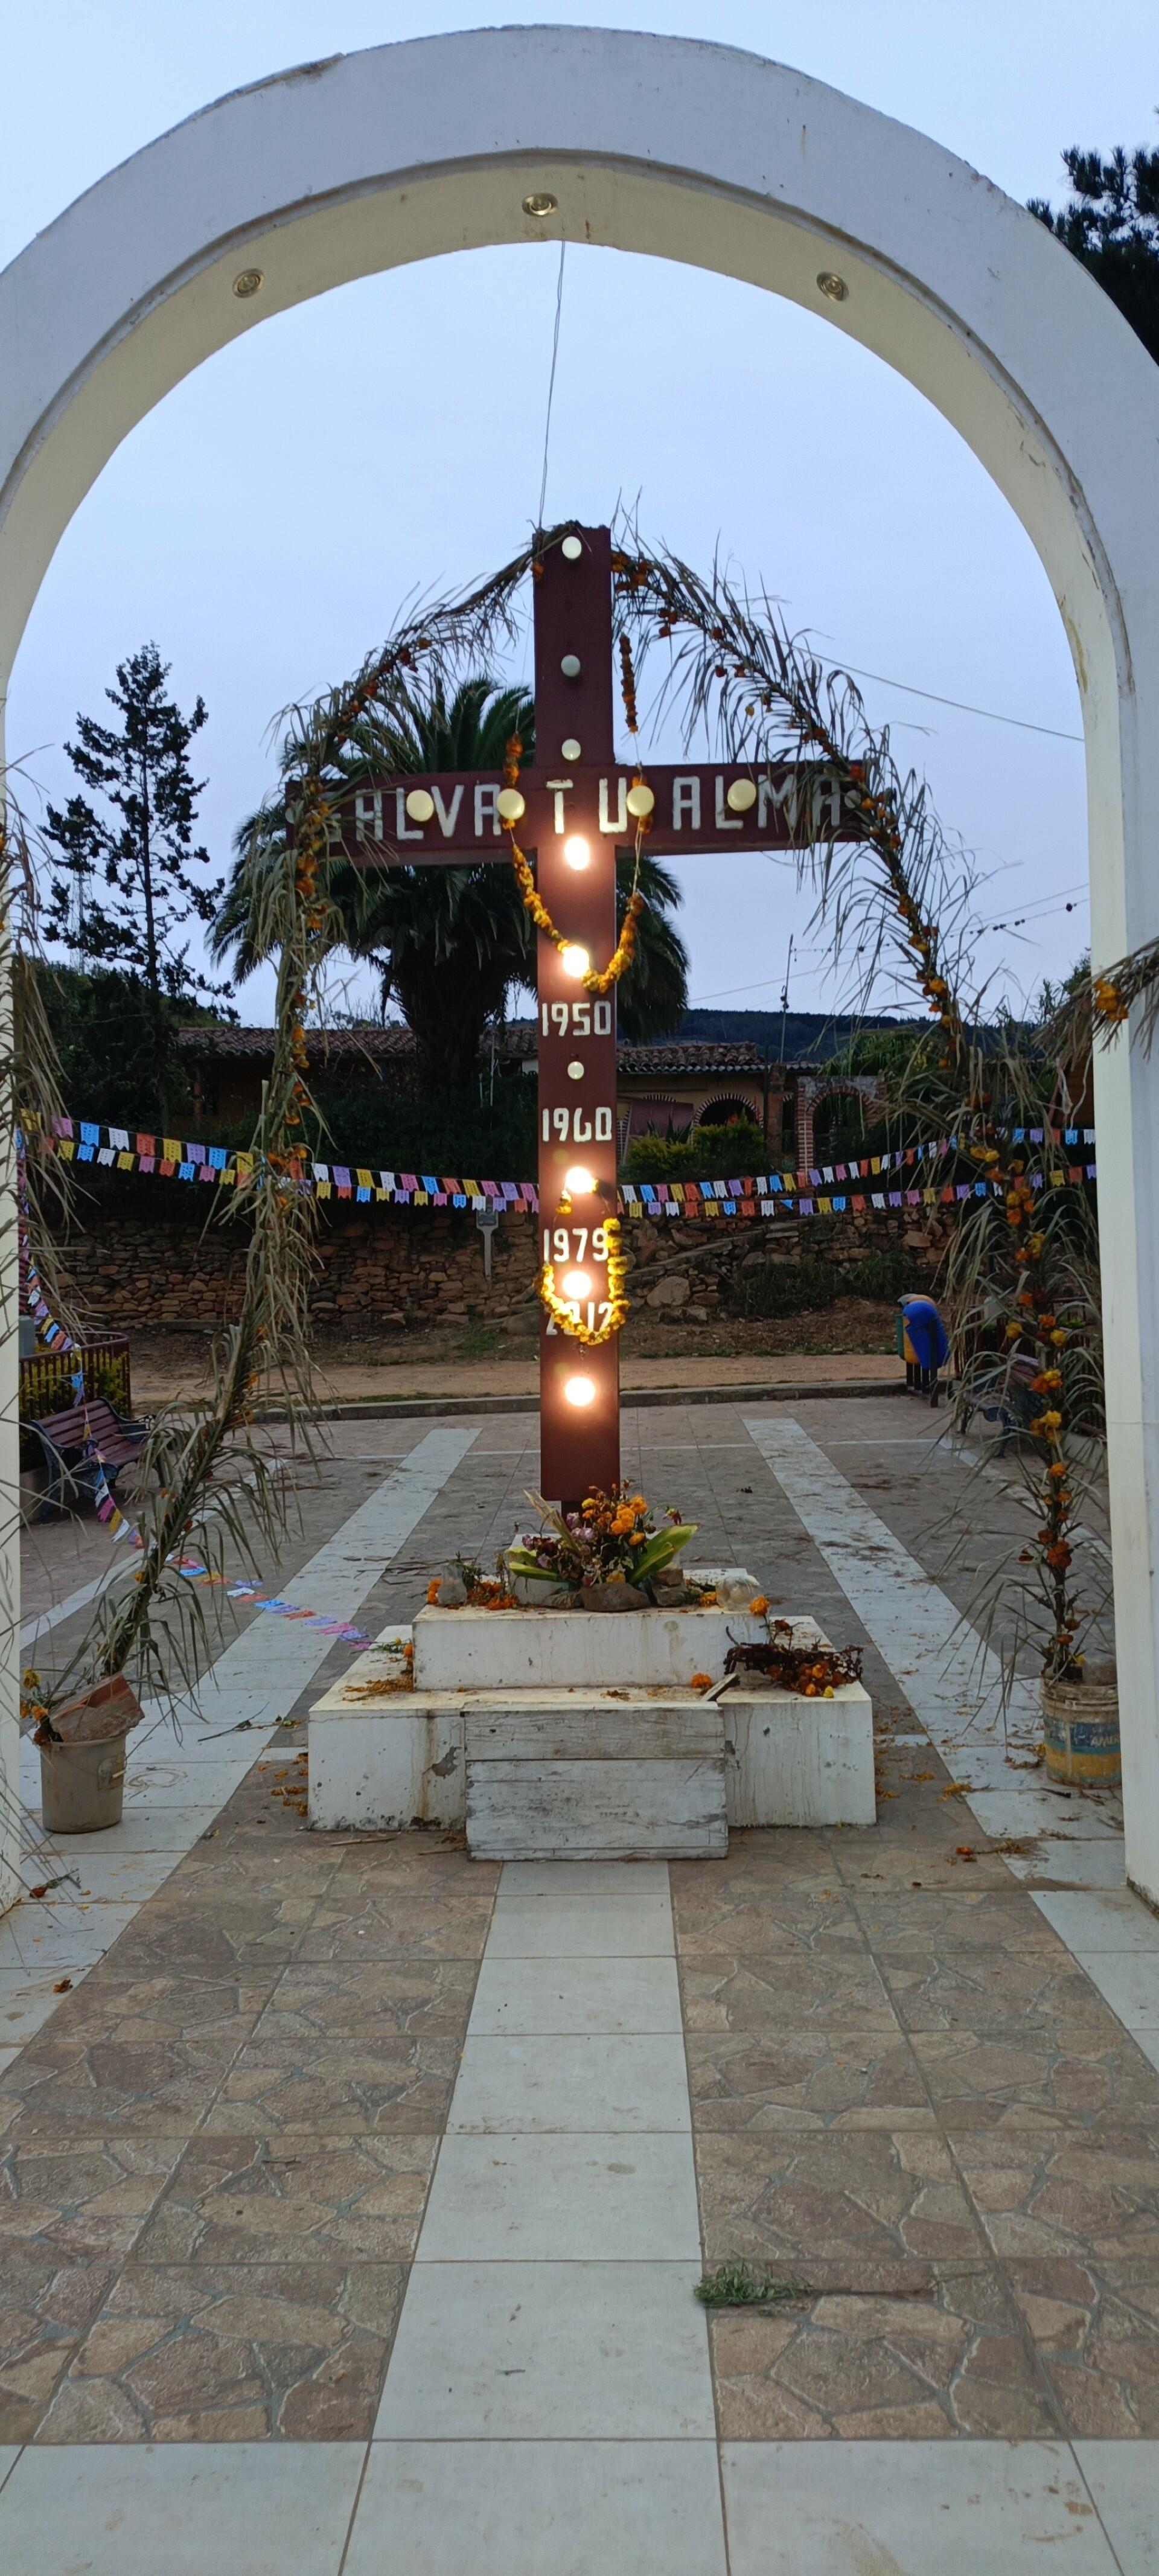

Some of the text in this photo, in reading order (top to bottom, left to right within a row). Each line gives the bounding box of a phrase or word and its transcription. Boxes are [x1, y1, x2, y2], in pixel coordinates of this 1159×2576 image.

[546, 778, 627, 834] TU
[672, 775, 840, 830] ALMA
[542, 1001, 612, 1037] 1950
[542, 1107, 613, 1143] 1960
[543, 1227, 610, 1264] 1979
